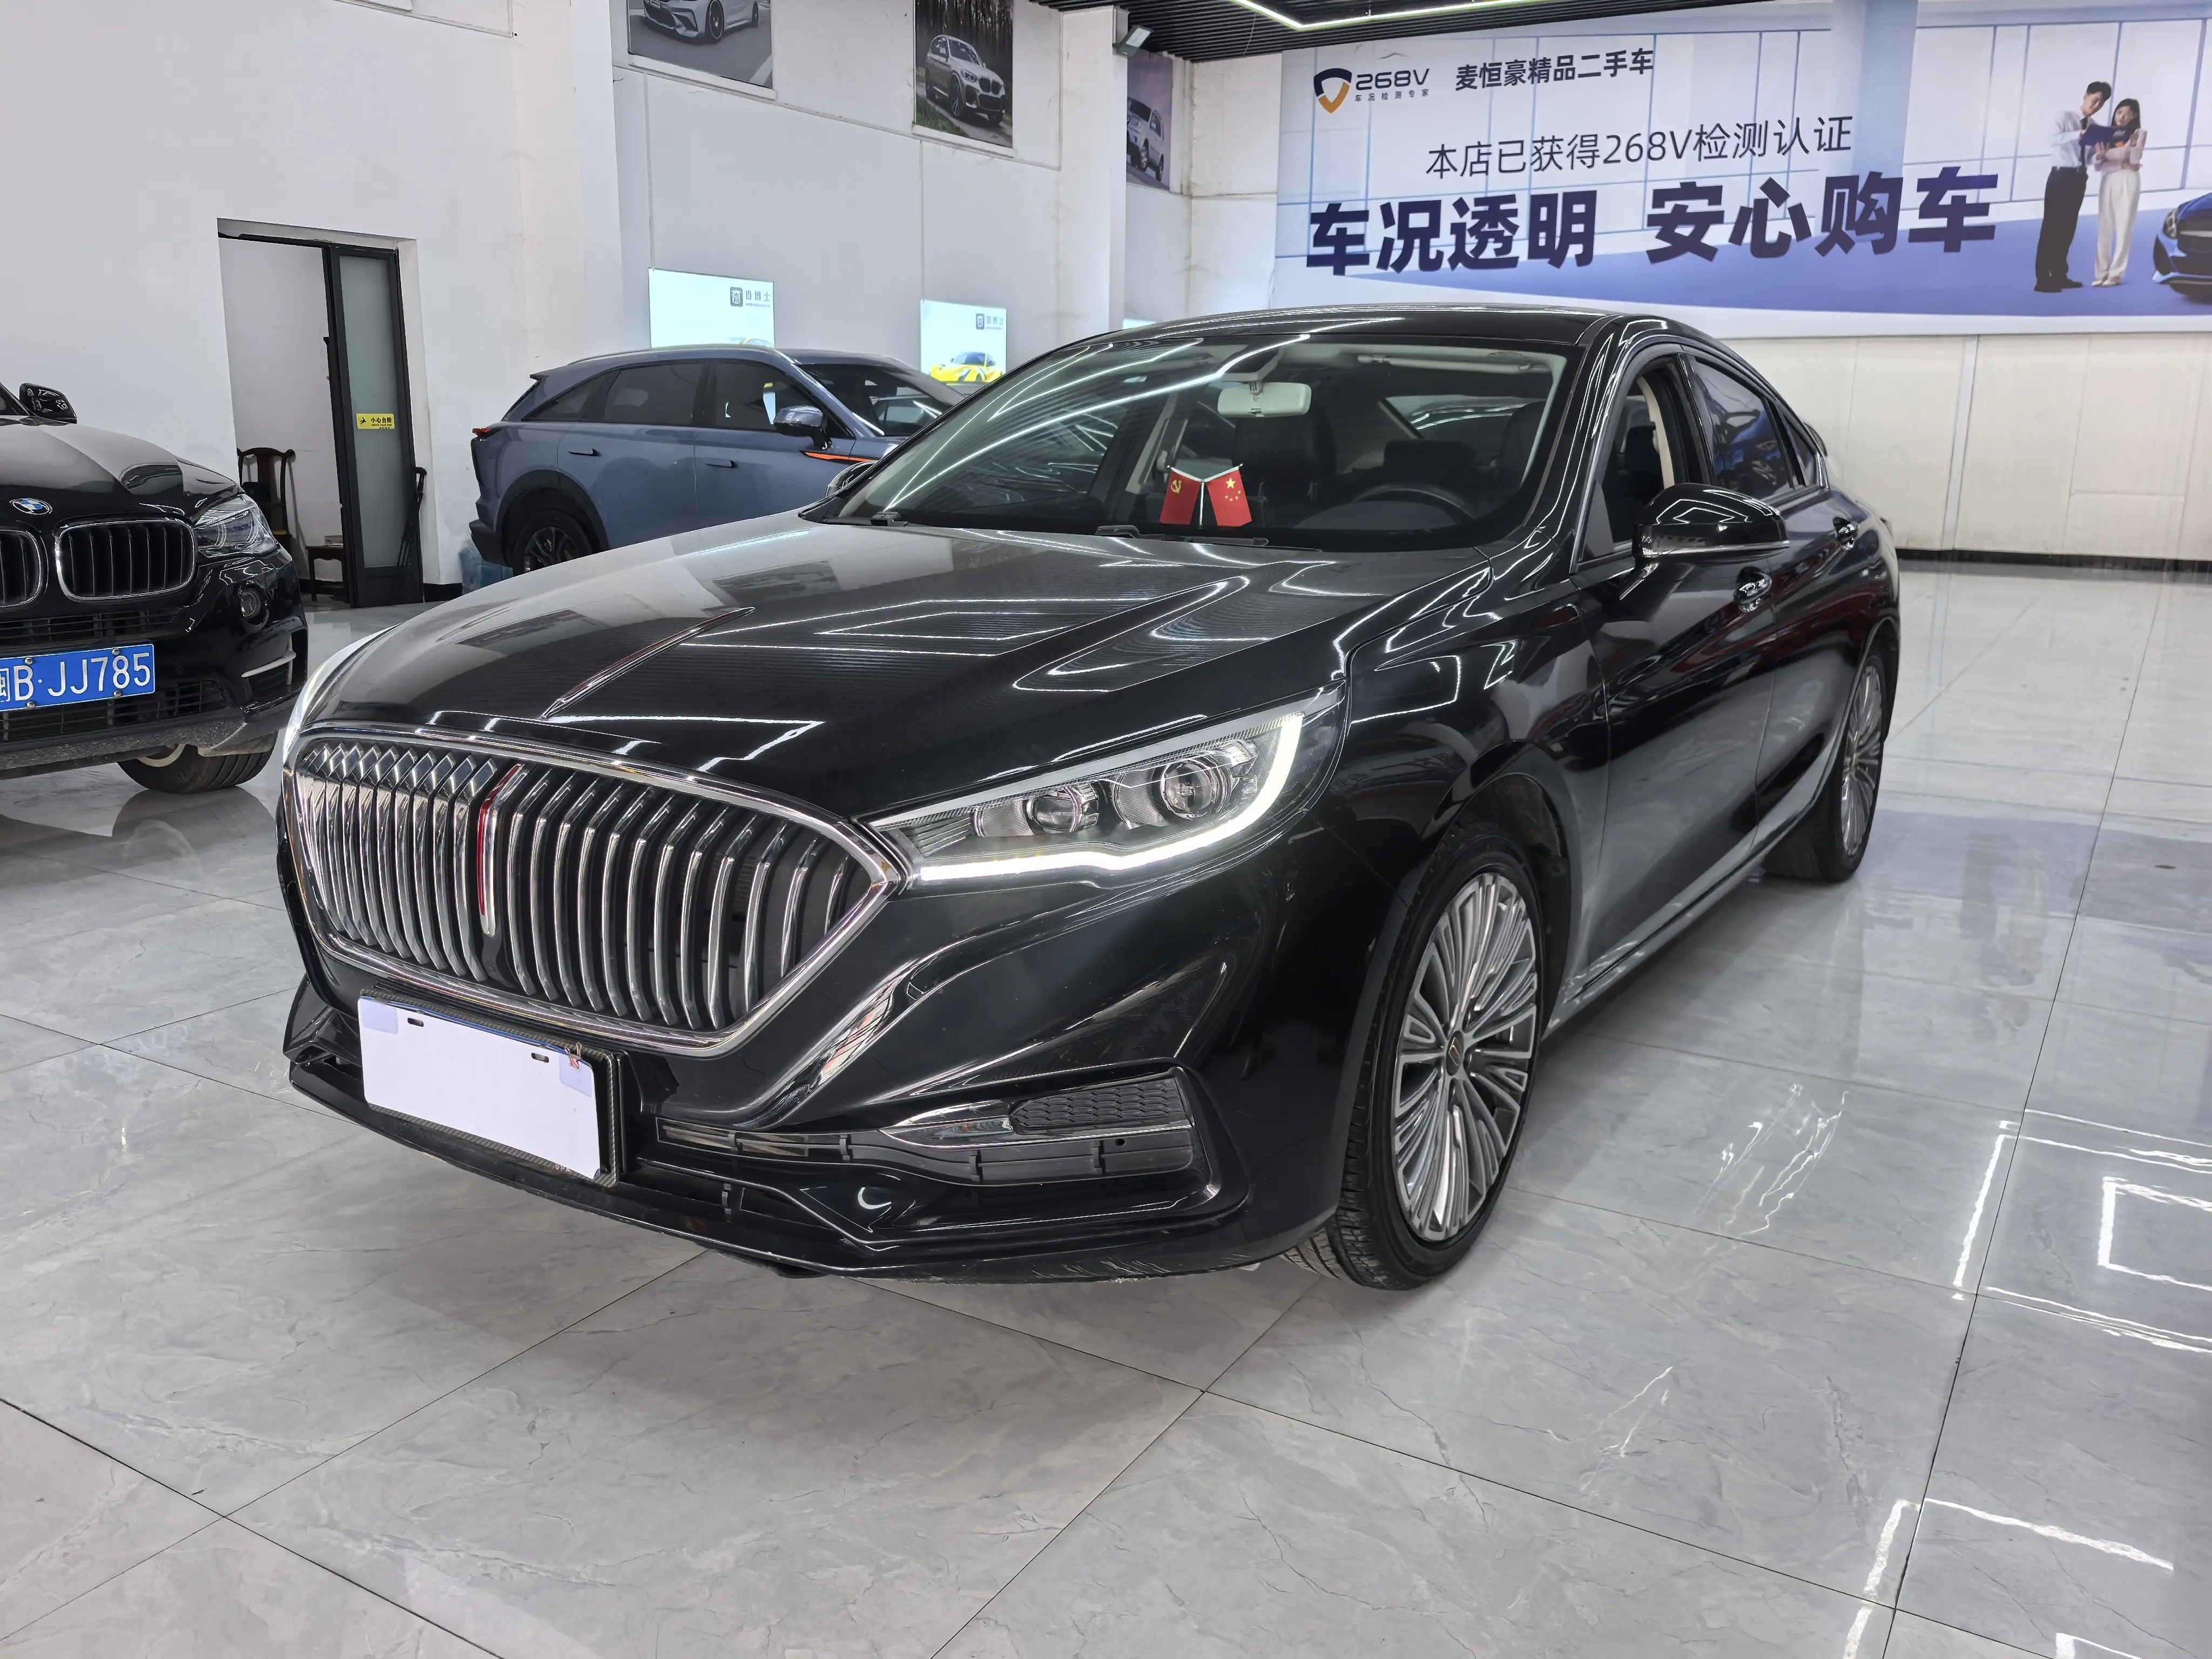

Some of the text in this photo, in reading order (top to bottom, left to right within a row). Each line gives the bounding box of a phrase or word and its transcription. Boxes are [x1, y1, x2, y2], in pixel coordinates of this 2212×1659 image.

[1355, 69, 1430, 90] 268V
[1455, 47, 1654, 91] 麦恒豪精品二手车
[1426, 115, 1853, 179] 本店已获得268V检测认证
[1306, 167, 1999, 276] 车况透明 安心购车
